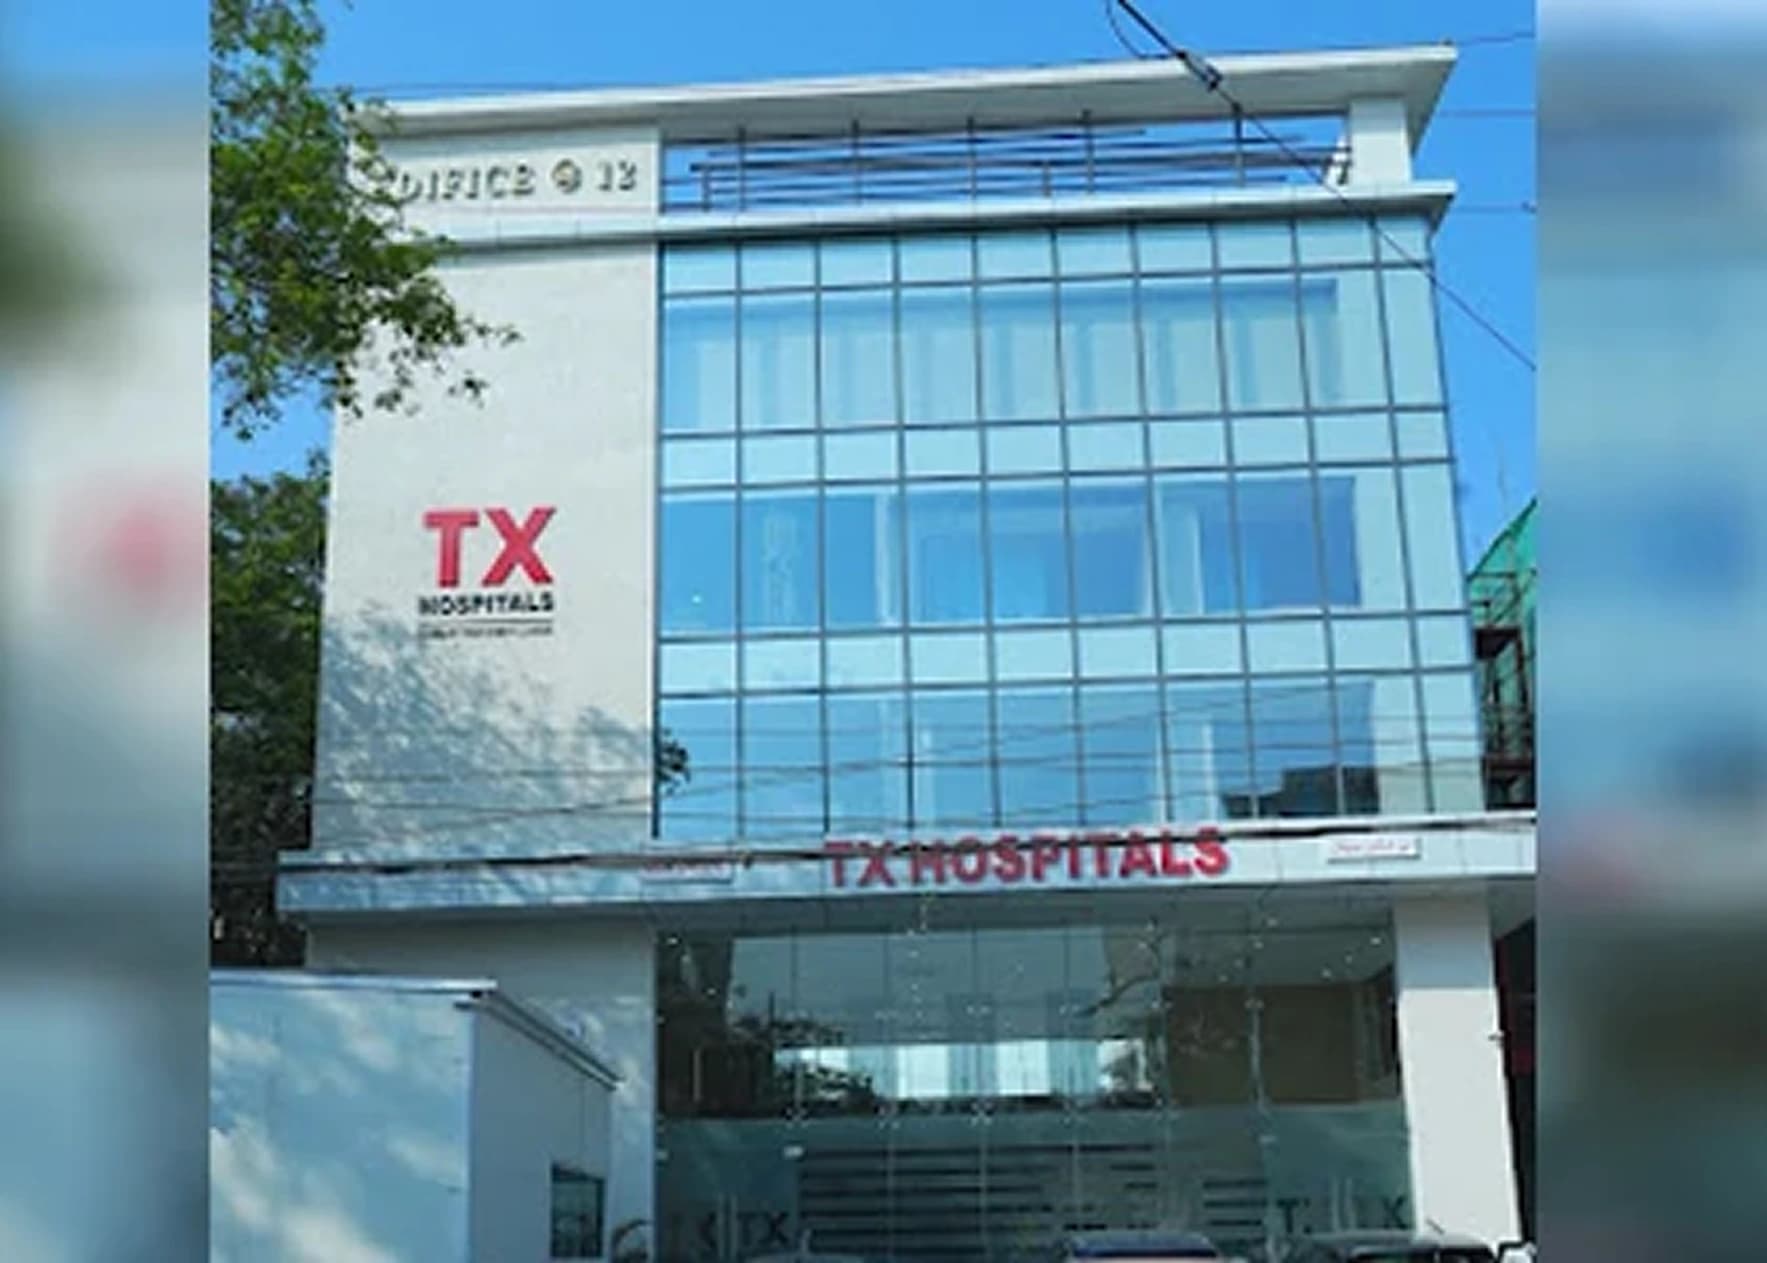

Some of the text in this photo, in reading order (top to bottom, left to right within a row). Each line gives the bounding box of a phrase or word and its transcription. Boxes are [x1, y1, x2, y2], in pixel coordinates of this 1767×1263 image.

[382, 163, 536, 204] DIFICE
[423, 506, 556, 588] TX
[418, 591, 554, 615] HOSPITALS
[825, 827, 1228, 887] TX HOSPITALS
